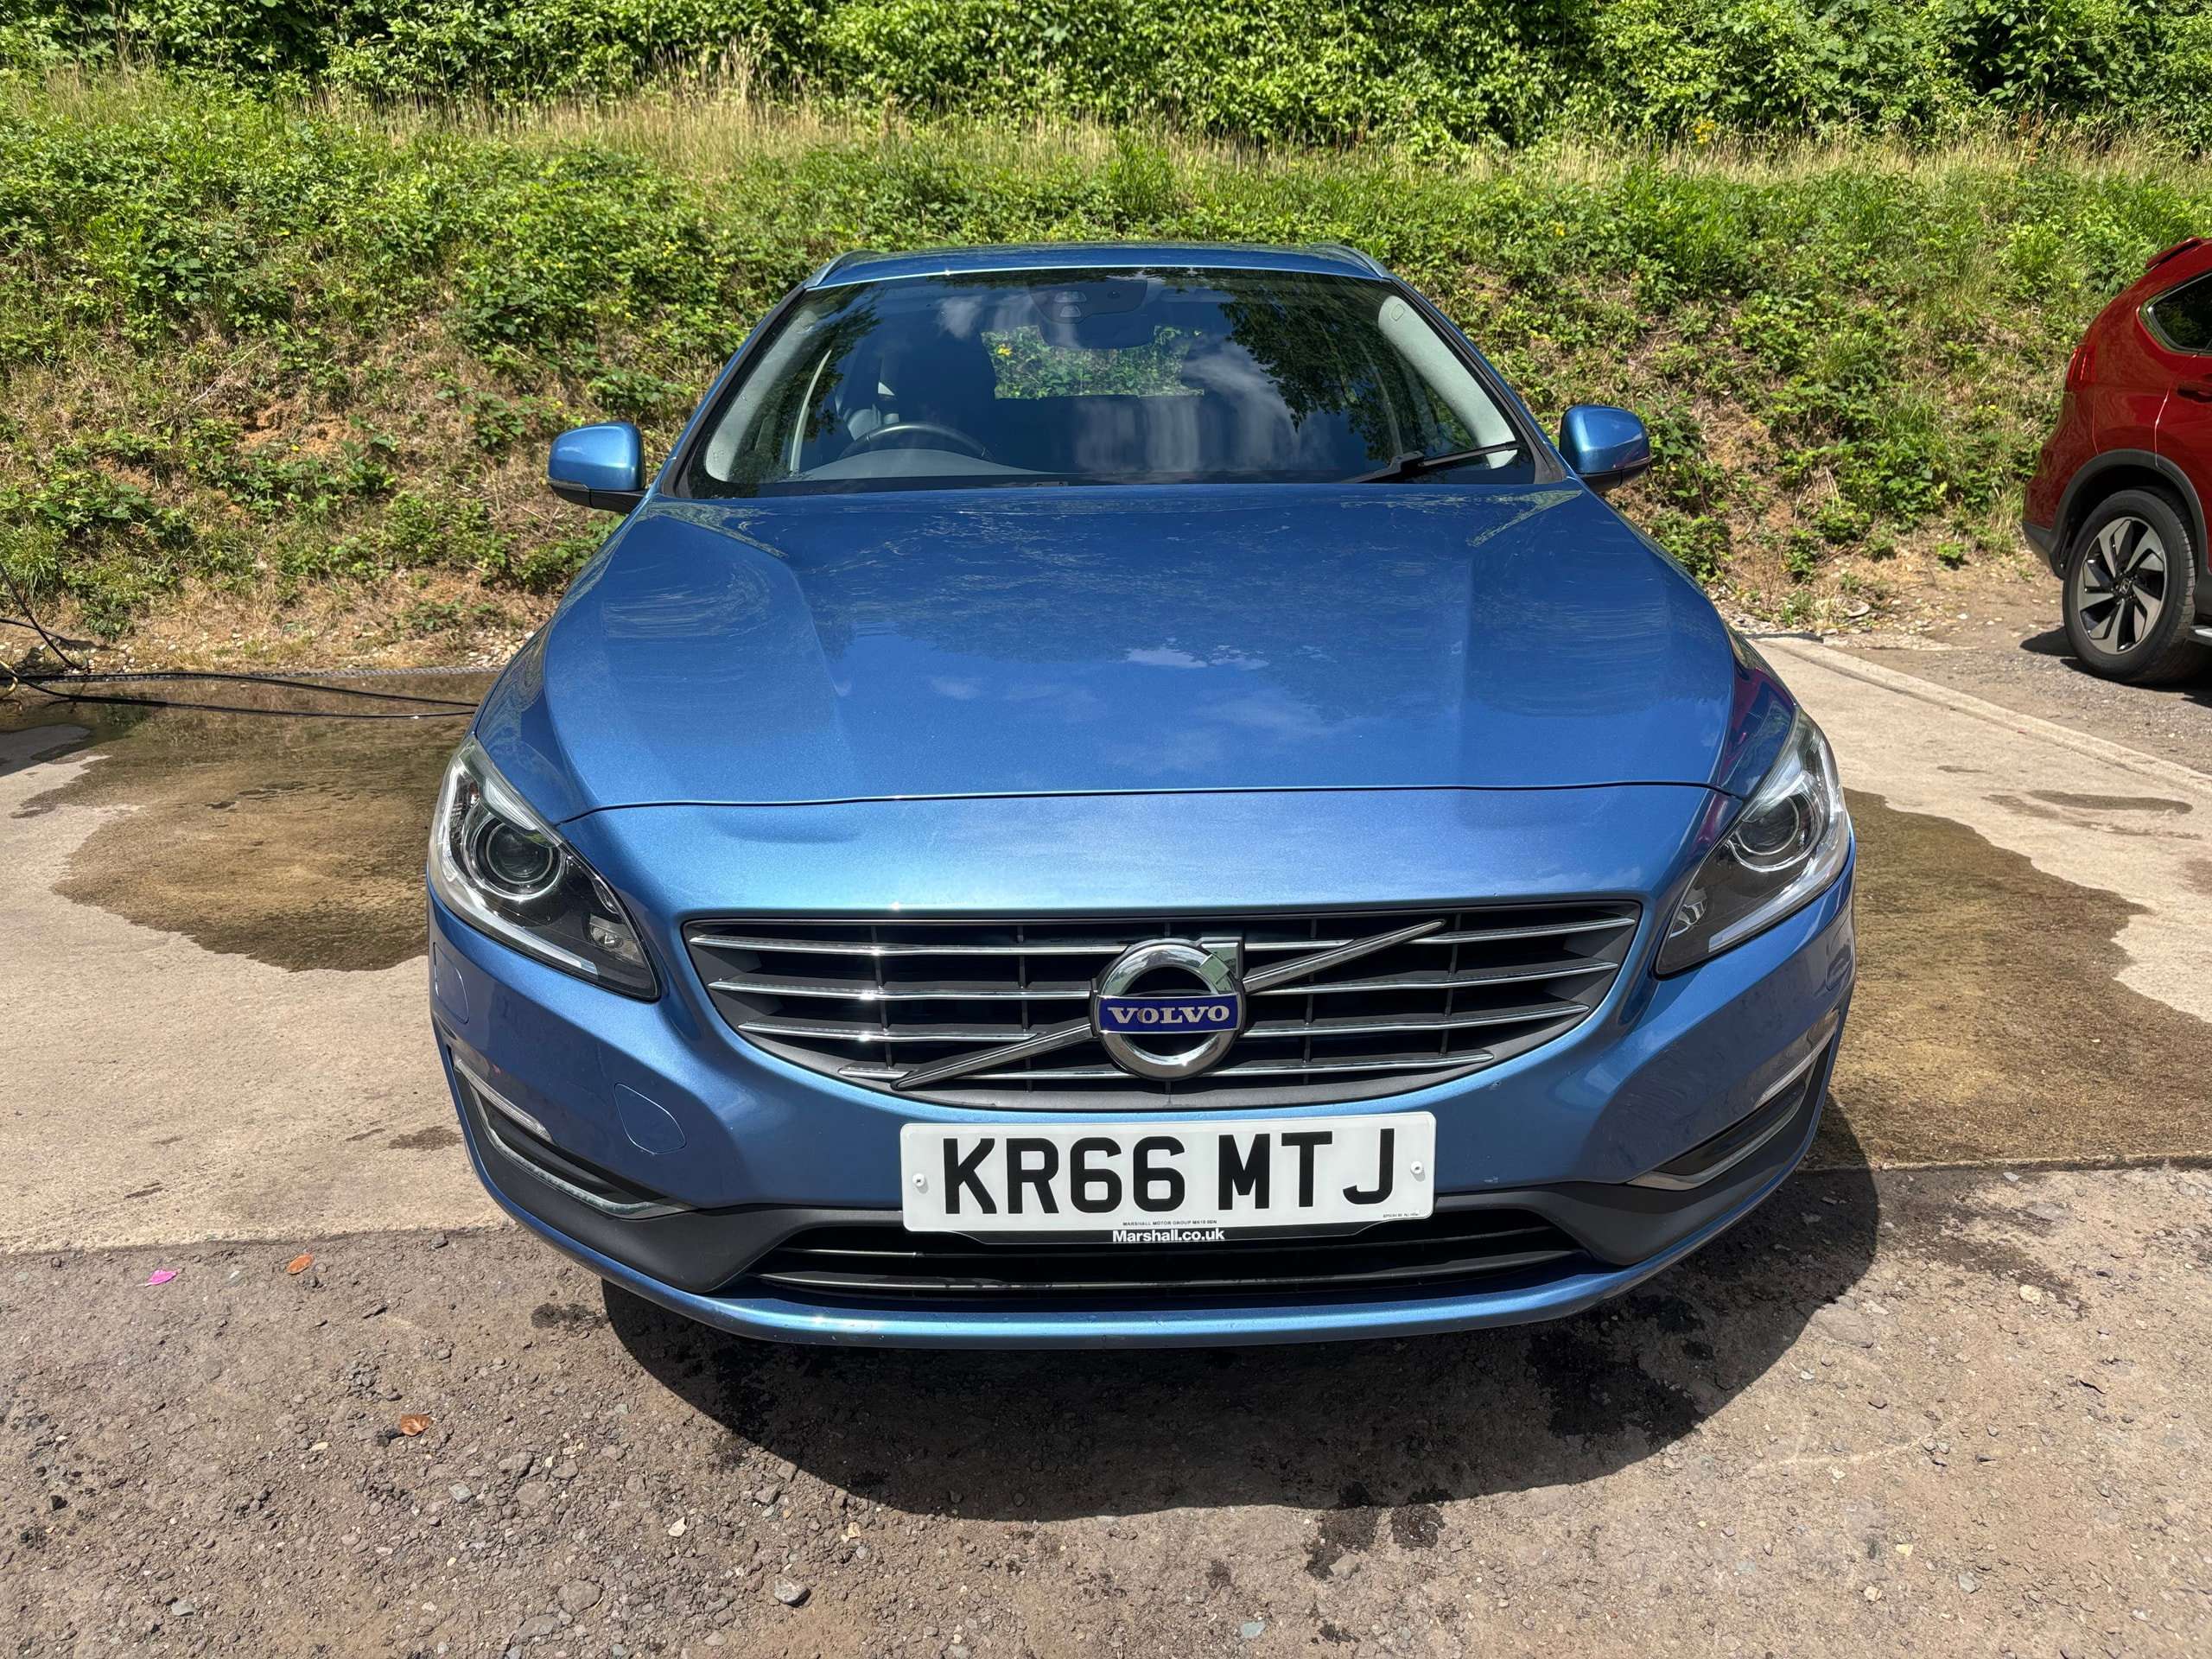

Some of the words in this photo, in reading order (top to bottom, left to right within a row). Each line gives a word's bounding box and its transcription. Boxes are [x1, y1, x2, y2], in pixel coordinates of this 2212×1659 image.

[1108, 1005, 1230, 1024] VOLVO
[943, 1135, 1185, 1215] KR66
[1217, 1128, 1395, 1211] MTJ
[1112, 1227, 1226, 1243] Marshall.co.uk
